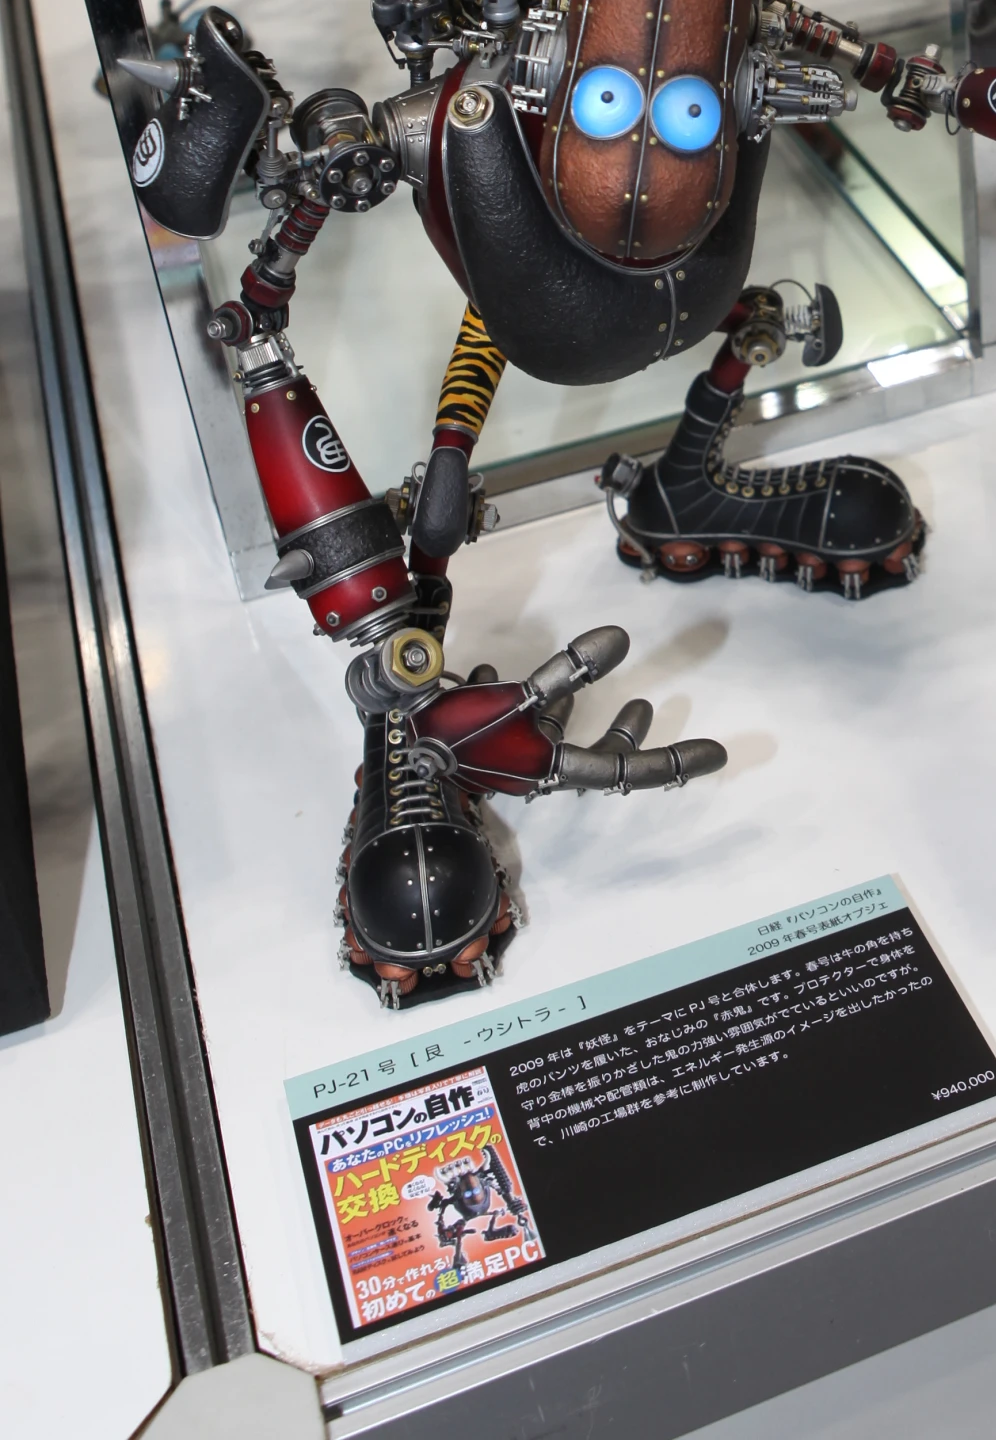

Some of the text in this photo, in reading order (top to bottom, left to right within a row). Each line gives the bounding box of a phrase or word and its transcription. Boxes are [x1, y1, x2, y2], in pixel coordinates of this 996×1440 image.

[929, 1067, 996, 1104] ¥940,000
[316, 1081, 476, 1157] パソコンの自作
[329, 1118, 503, 1200] ハードディスクの
[334, 1179, 401, 1226] 交換
[354, 1248, 452, 1301] 30分で作れる!
[359, 1238, 540, 1323] 初めての超満足PC
